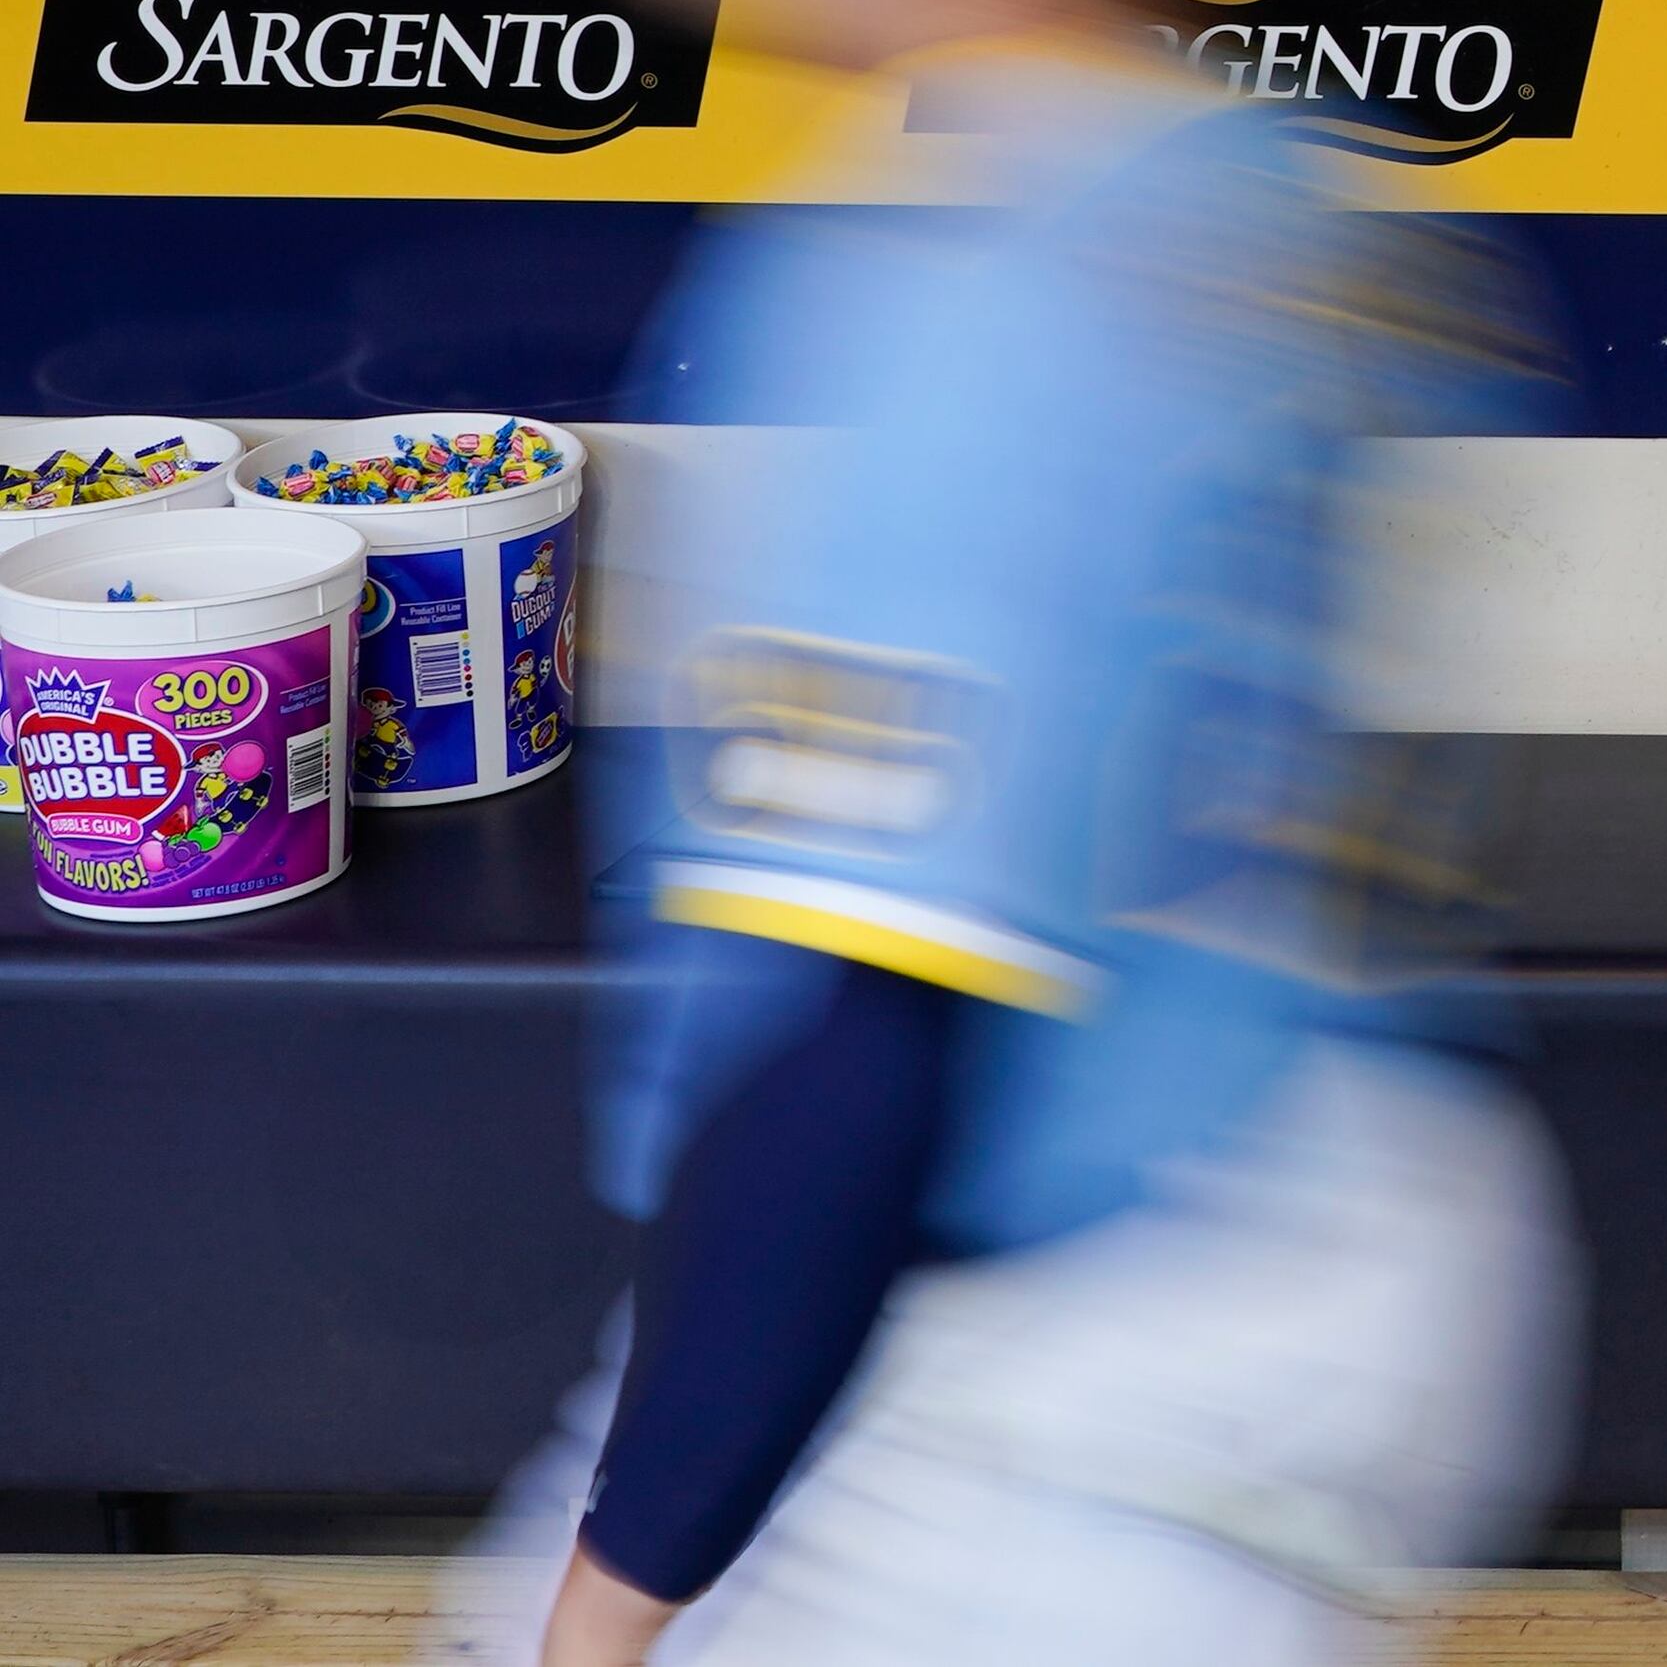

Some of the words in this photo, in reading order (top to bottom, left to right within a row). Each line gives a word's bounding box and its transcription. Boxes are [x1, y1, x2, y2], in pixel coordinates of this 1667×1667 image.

[511, 586, 556, 623] DUGOUT
[37, 688, 96, 706] AMERICA'S
[152, 666, 250, 713] 300
[20, 732, 155, 767] DUBBLE
[29, 766, 167, 803] BUBBLE
[93, 819, 132, 836] GUM
[56, 848, 149, 892] FLAVORS!
